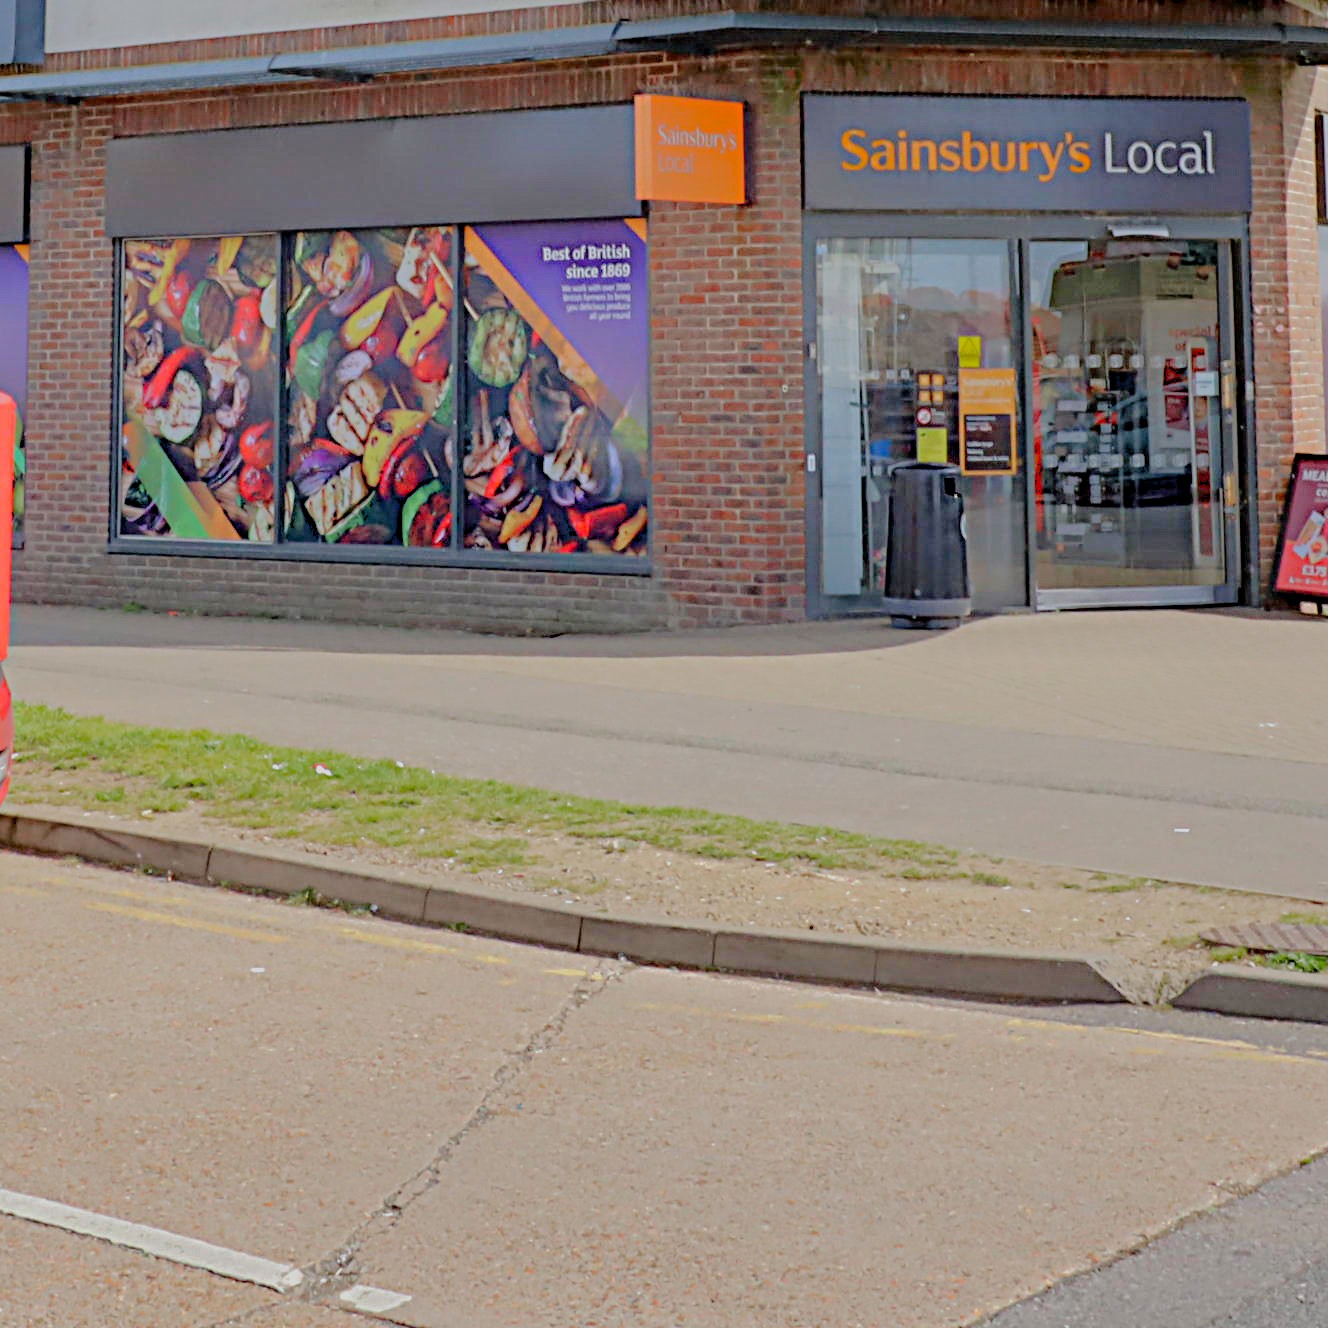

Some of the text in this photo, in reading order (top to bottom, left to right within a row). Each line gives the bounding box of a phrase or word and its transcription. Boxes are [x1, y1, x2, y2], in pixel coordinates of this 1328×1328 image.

[657, 123, 737, 154] Sainsbury's
[657, 154, 694, 174] Local
[840, 128, 1216, 182] Sainsbury's Local
[542, 243, 630, 261] Best of British
[566, 263, 630, 279] since 1869
